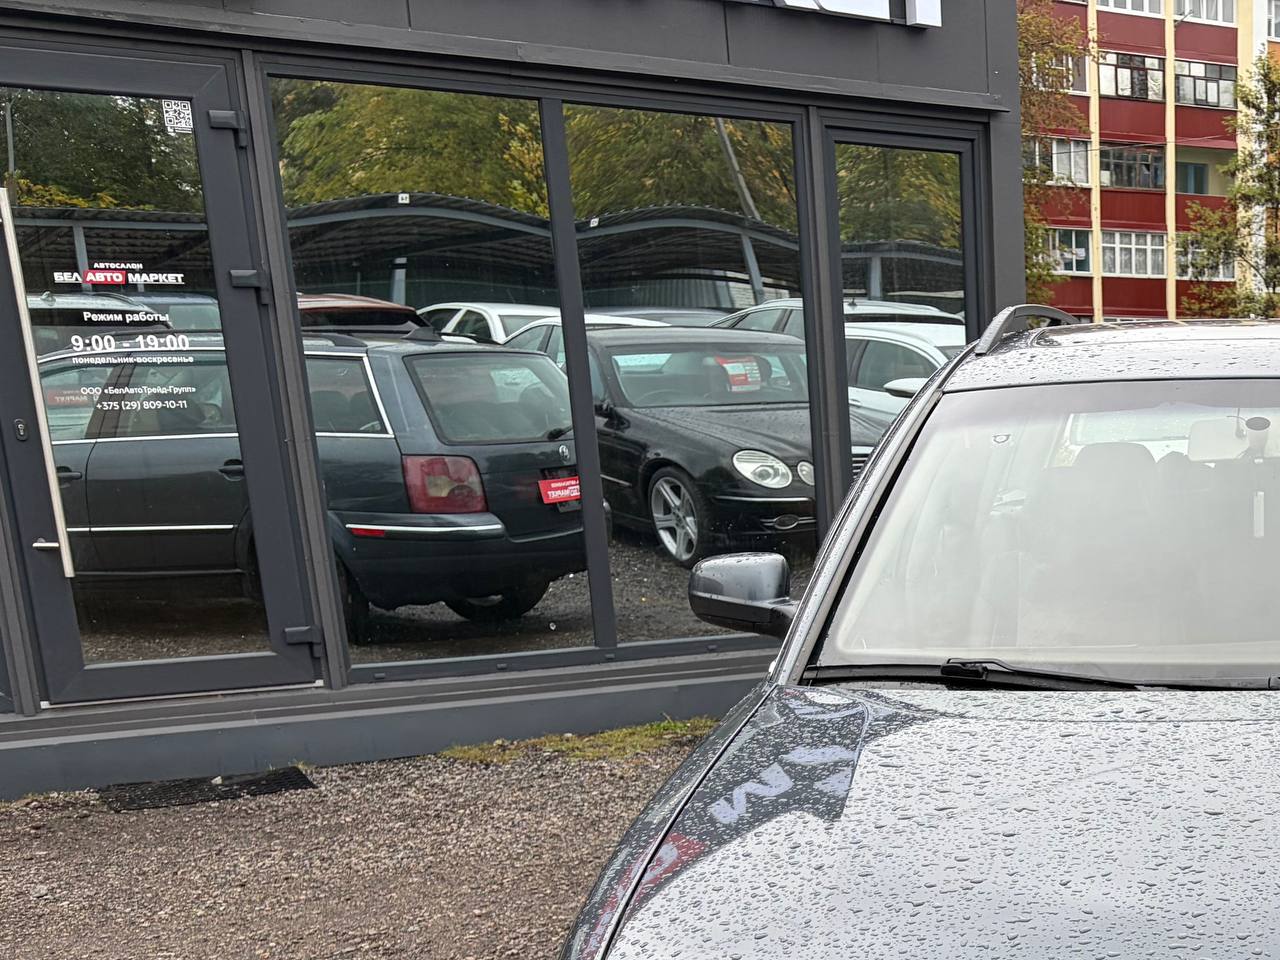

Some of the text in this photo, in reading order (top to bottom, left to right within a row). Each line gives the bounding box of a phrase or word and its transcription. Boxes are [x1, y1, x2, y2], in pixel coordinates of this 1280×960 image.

[53, 272, 184, 282] БЕЛ АВТО МАРКЕТ
[83, 311, 169, 323] Режим работы
[71, 335, 115, 351] 9:00
[135, 335, 190, 350] 19:00
[72, 355, 194, 364] понедельник-воскресенье
[80, 387, 102, 395] ООО
[104, 386, 196, 395] «БелАвтоТрейд-Групп»
[96, 400, 187, 410] +375 (29) 809-10-11
